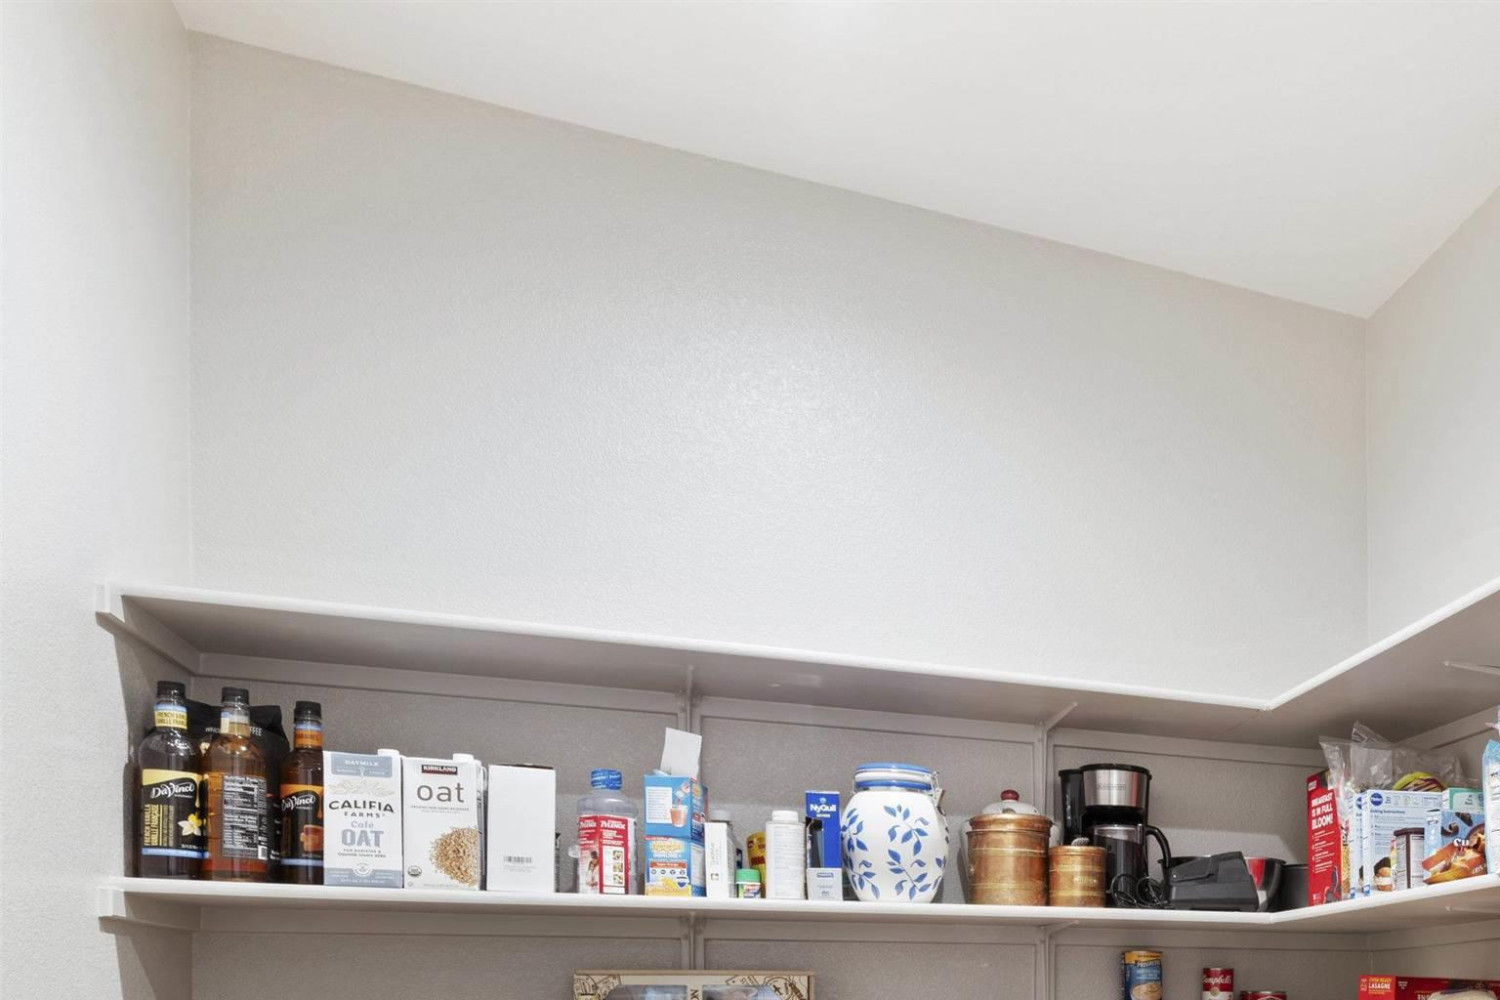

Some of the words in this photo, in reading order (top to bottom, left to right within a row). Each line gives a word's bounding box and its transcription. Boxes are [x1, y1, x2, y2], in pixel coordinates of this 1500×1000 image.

[417, 783, 464, 802] oat
[329, 800, 394, 813] CALIFIA
[342, 829, 384, 847] OAT
